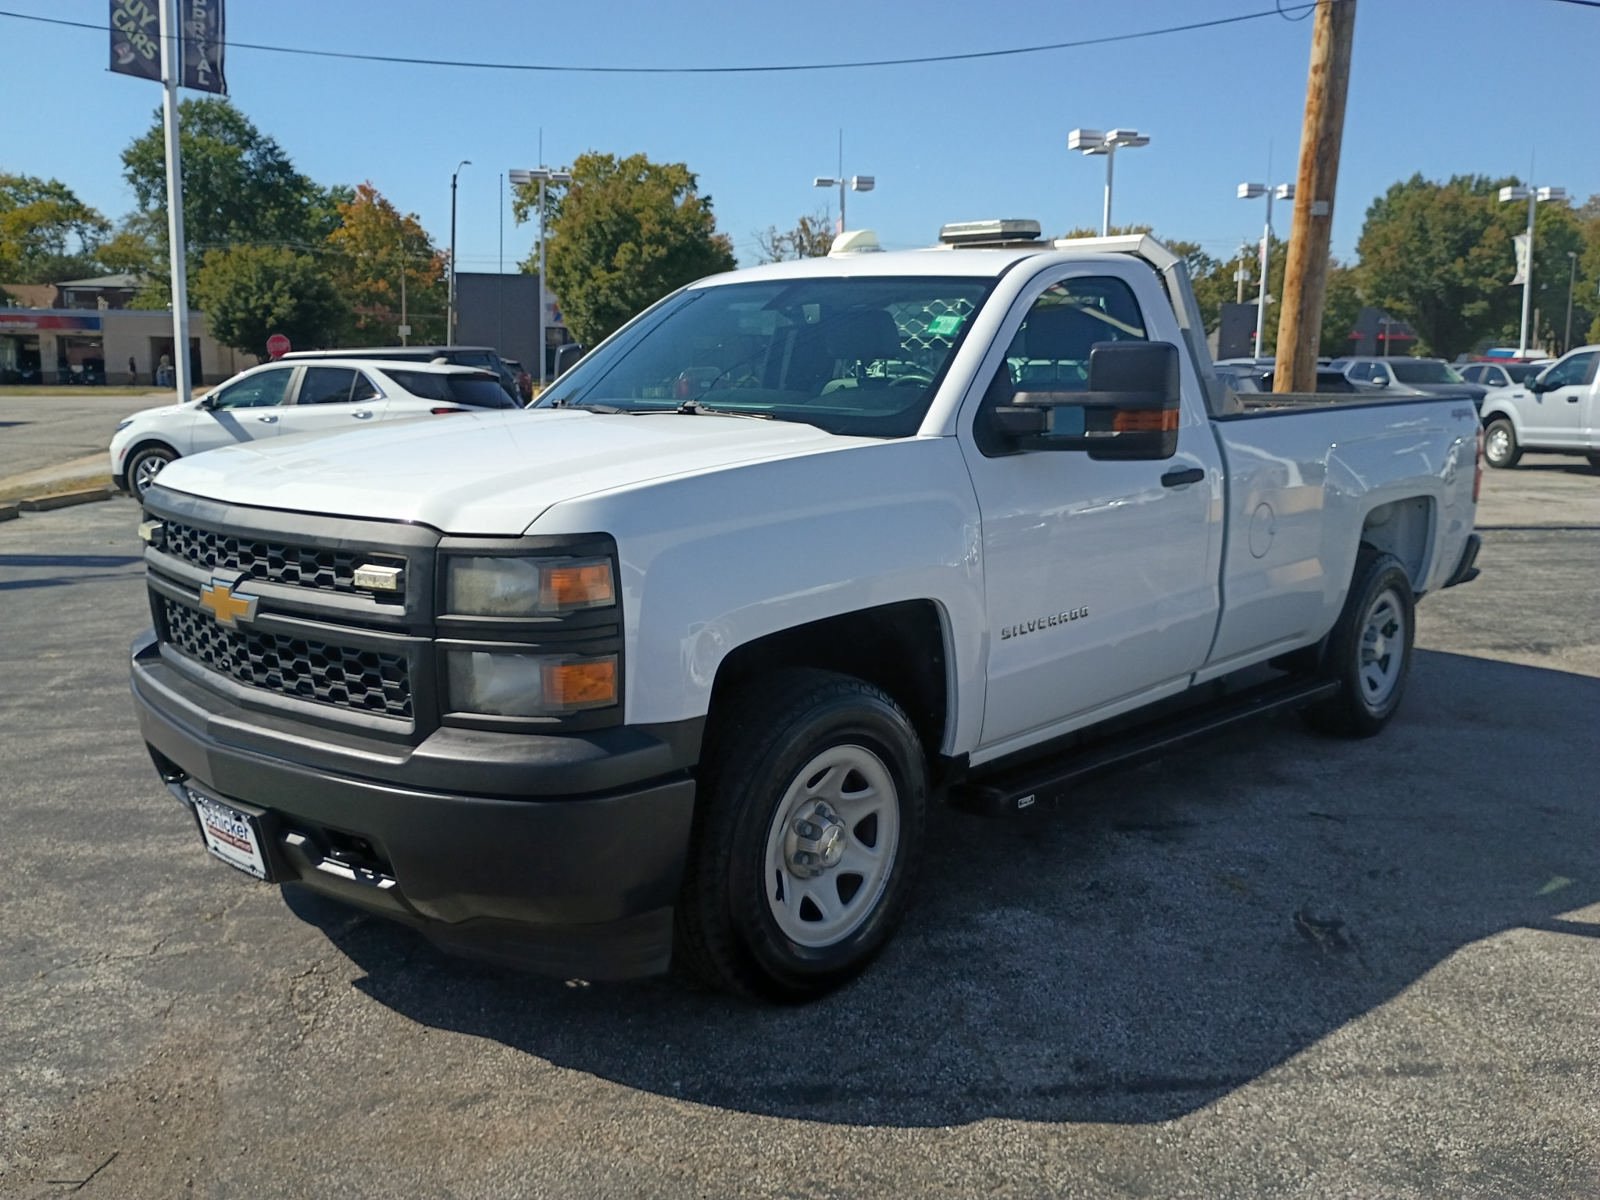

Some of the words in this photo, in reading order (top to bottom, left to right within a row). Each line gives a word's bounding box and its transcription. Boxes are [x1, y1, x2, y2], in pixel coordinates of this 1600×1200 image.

[121, 0, 157, 27] UY
[112, 8, 158, 60] CARS
[1001, 605, 1088, 640] SILVERADO
